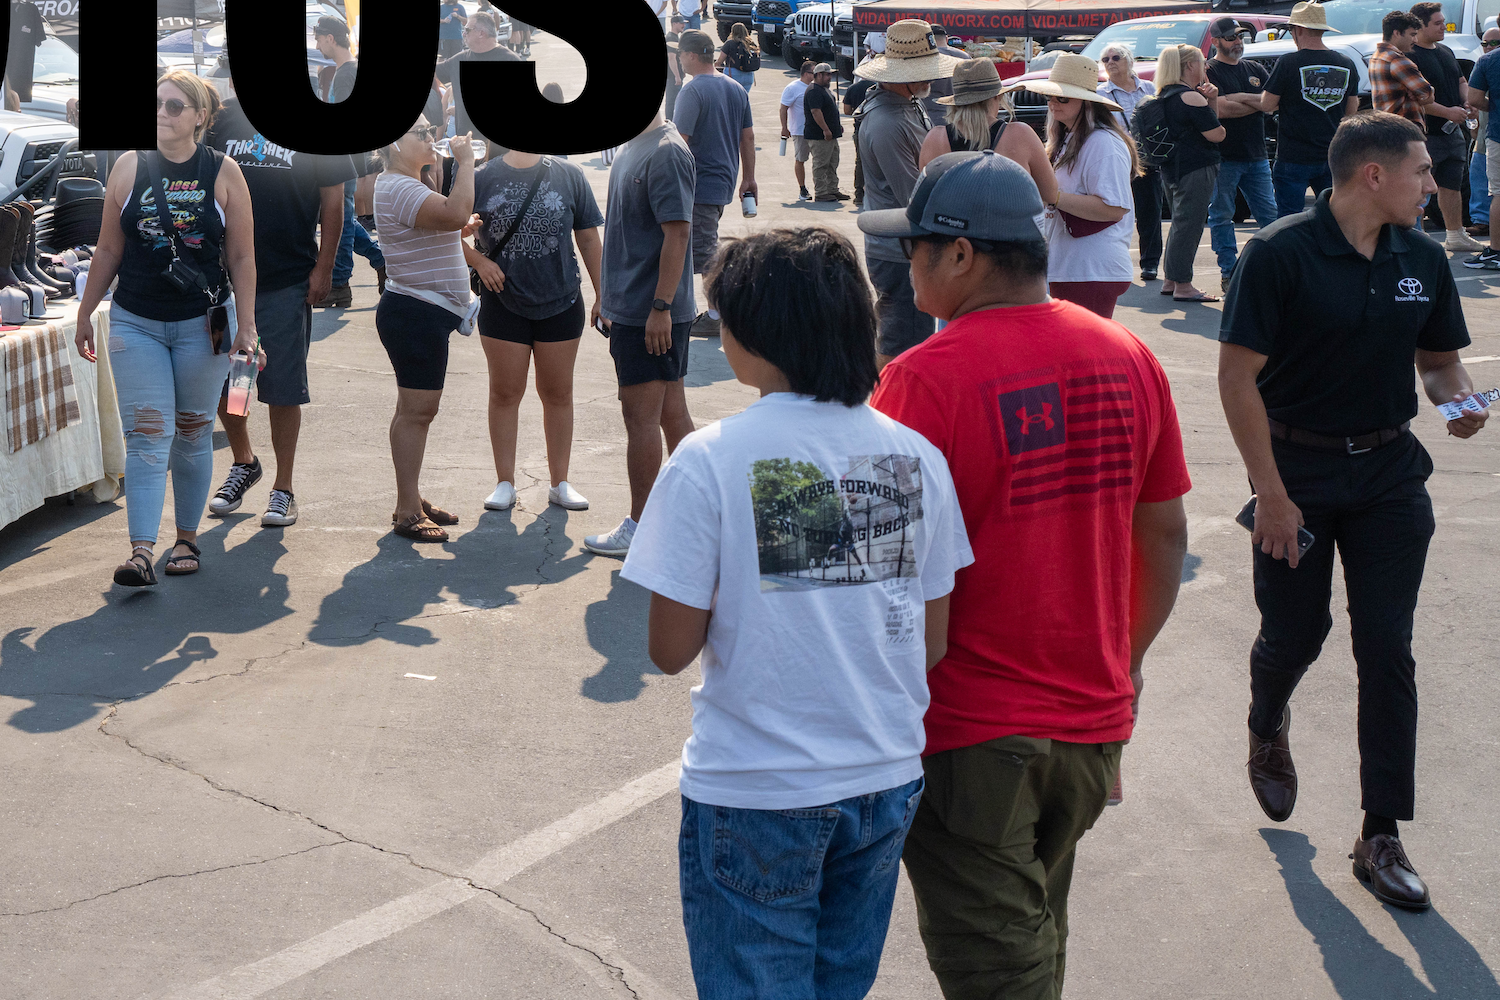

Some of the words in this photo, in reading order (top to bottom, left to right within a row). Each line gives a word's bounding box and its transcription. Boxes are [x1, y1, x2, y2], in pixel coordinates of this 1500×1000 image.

[61, 157, 84, 171] YOTA
[225, 139, 297, 167] THRSHER
[237, 160, 291, 169] AGAZINE
[140, 178, 207, 206] Cmaro
[169, 180, 199, 191] 1969
[840, 479, 910, 511] FORWARD
[872, 511, 911, 539] BACK
